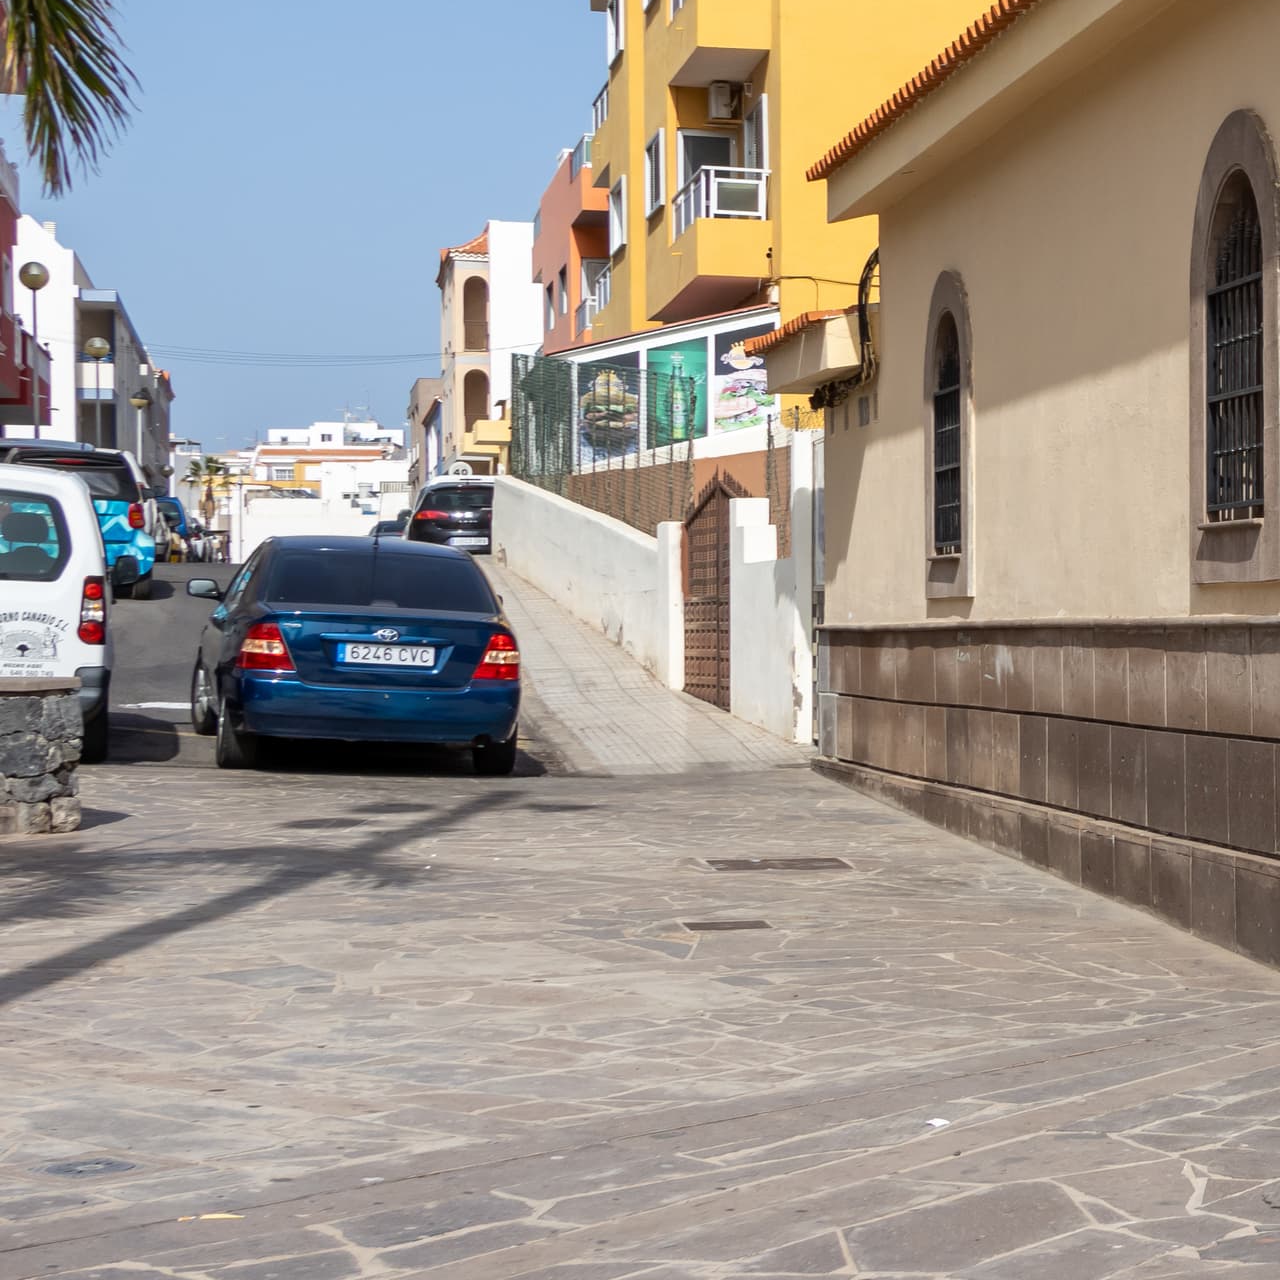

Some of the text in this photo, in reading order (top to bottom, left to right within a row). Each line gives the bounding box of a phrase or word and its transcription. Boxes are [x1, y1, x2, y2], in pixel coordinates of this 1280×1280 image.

[22, 611, 56, 625] CANARIO
[351, 646, 430, 663] 6246 CVC
